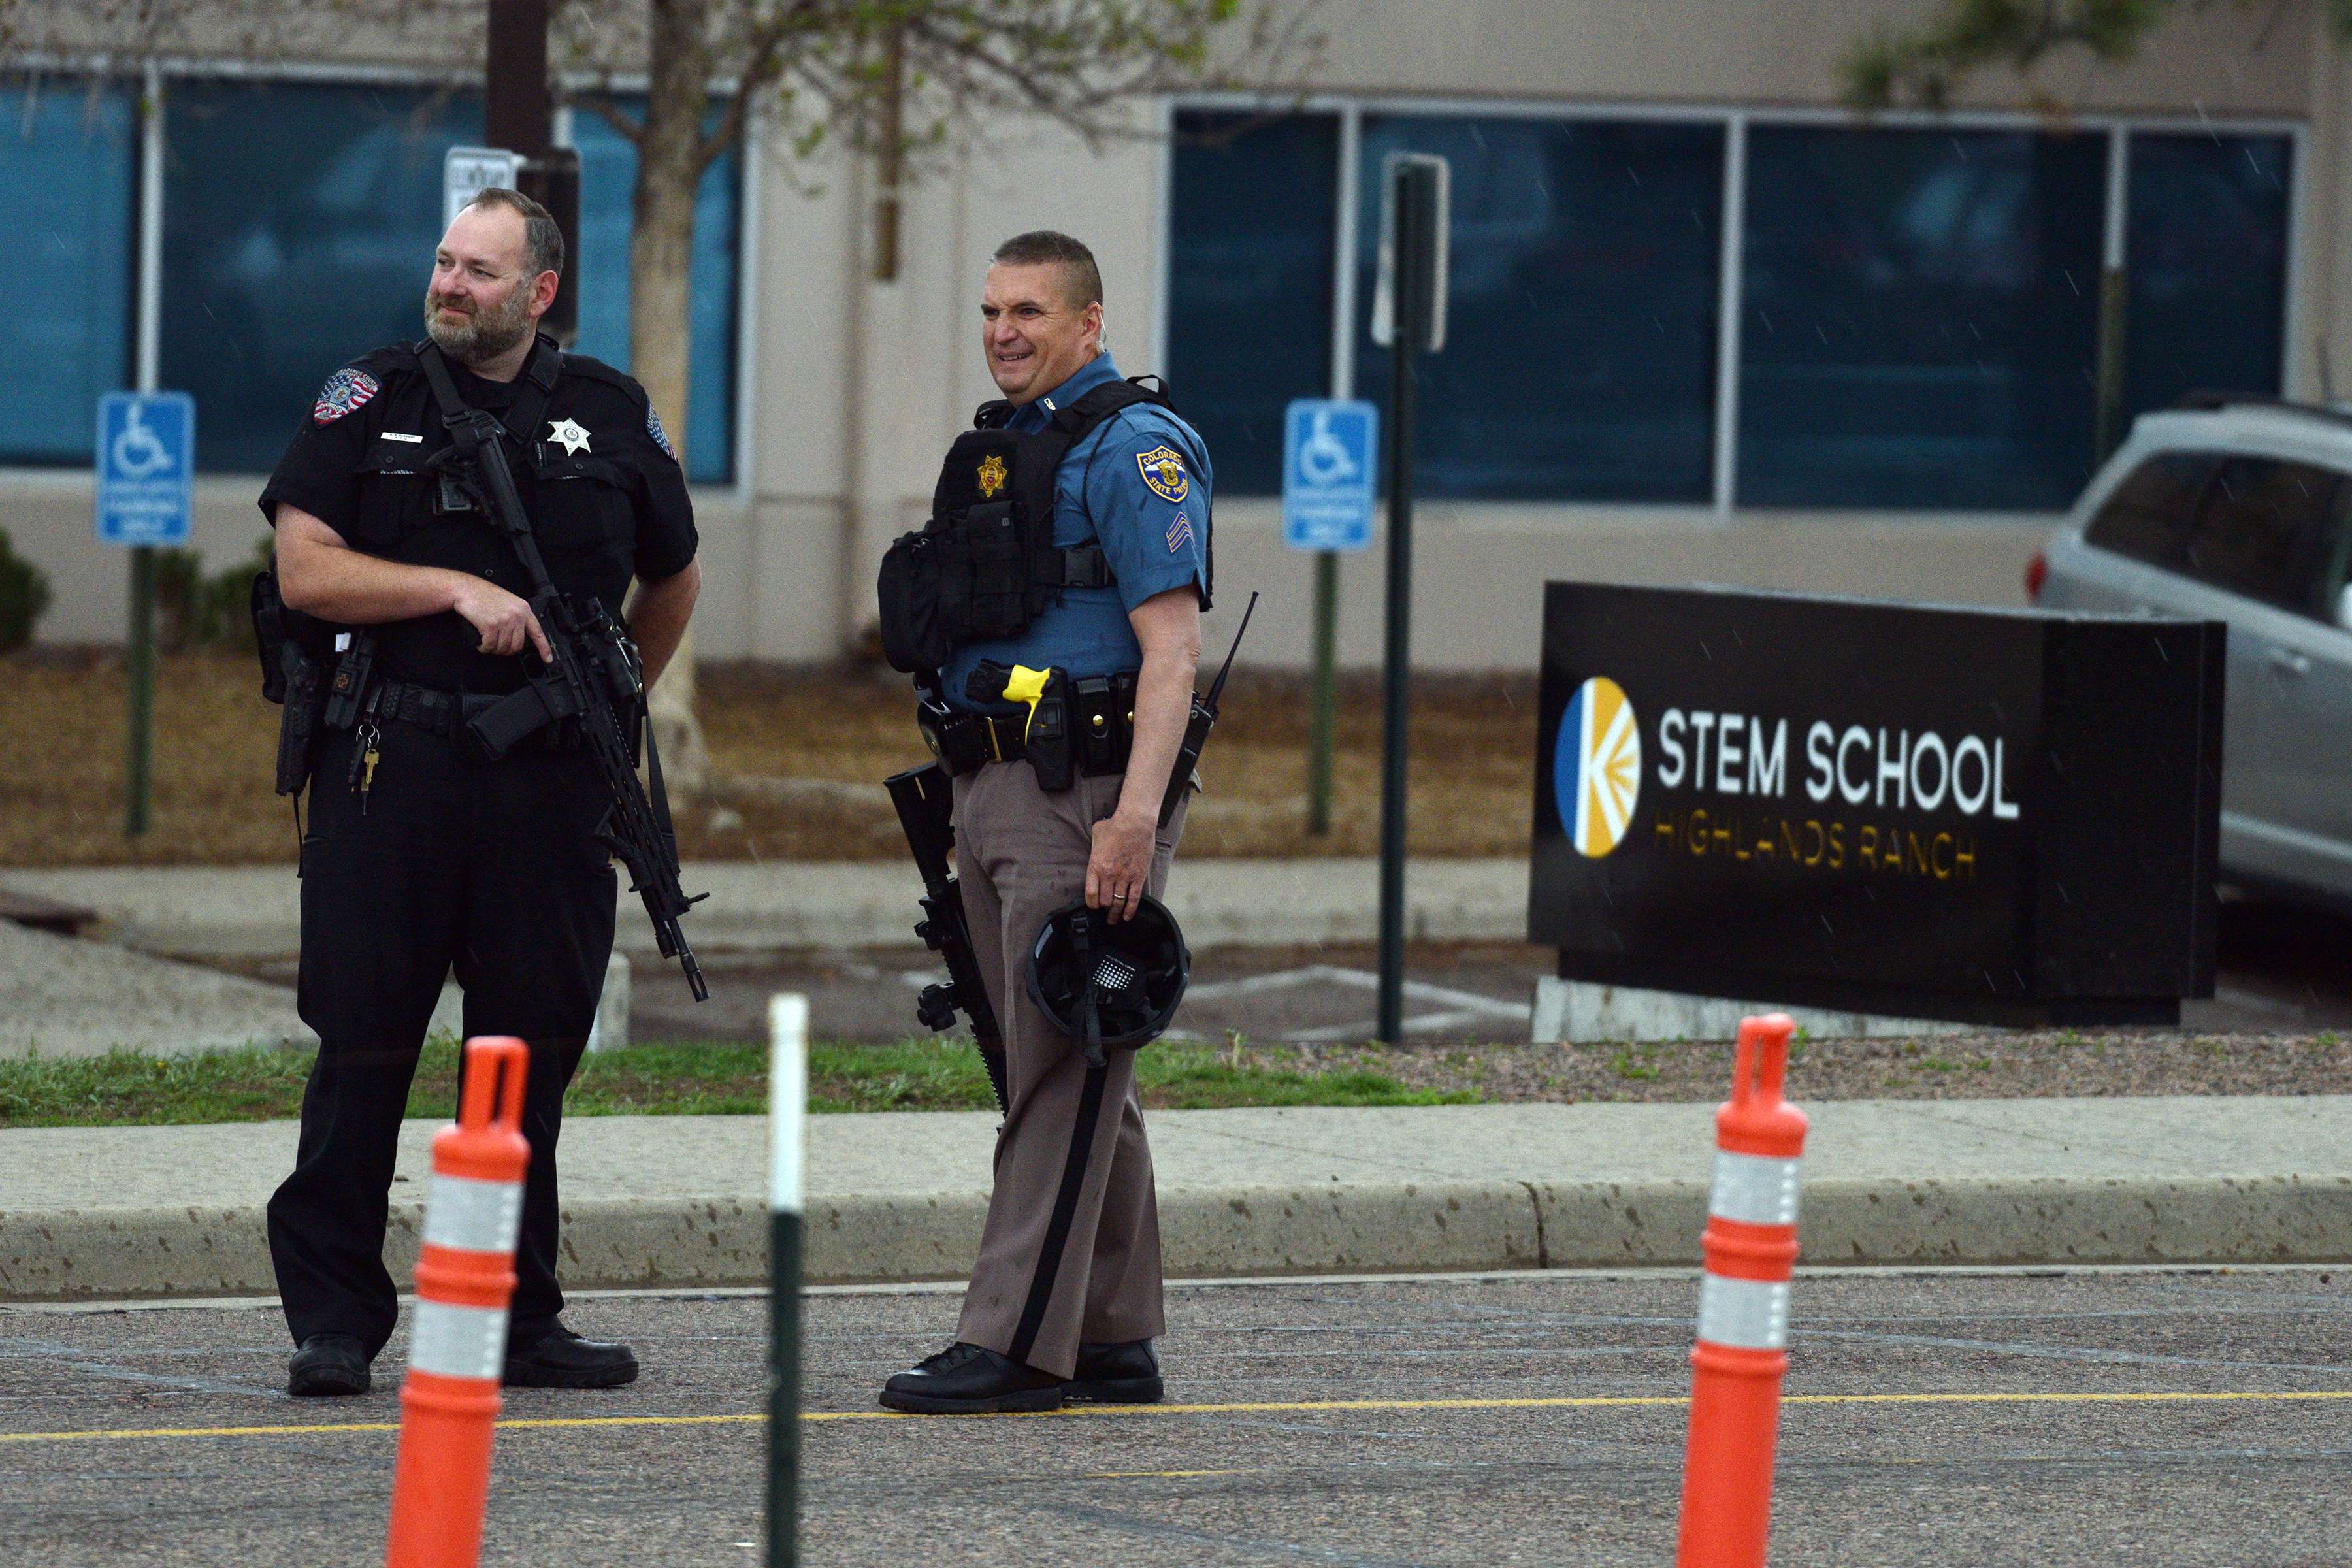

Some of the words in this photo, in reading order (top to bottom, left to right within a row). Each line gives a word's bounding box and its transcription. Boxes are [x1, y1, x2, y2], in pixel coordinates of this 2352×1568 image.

[1043, 397, 1056, 411] CSP
[1143, 451, 1183, 465] COLORADO
[1149, 476, 1171, 494] STATE
[1658, 707, 1788, 798] STEM
[1805, 720, 2020, 819] SCHOOL
[1654, 806, 1845, 869] HIGHLANDS
[1860, 824, 1977, 881] RANCH
